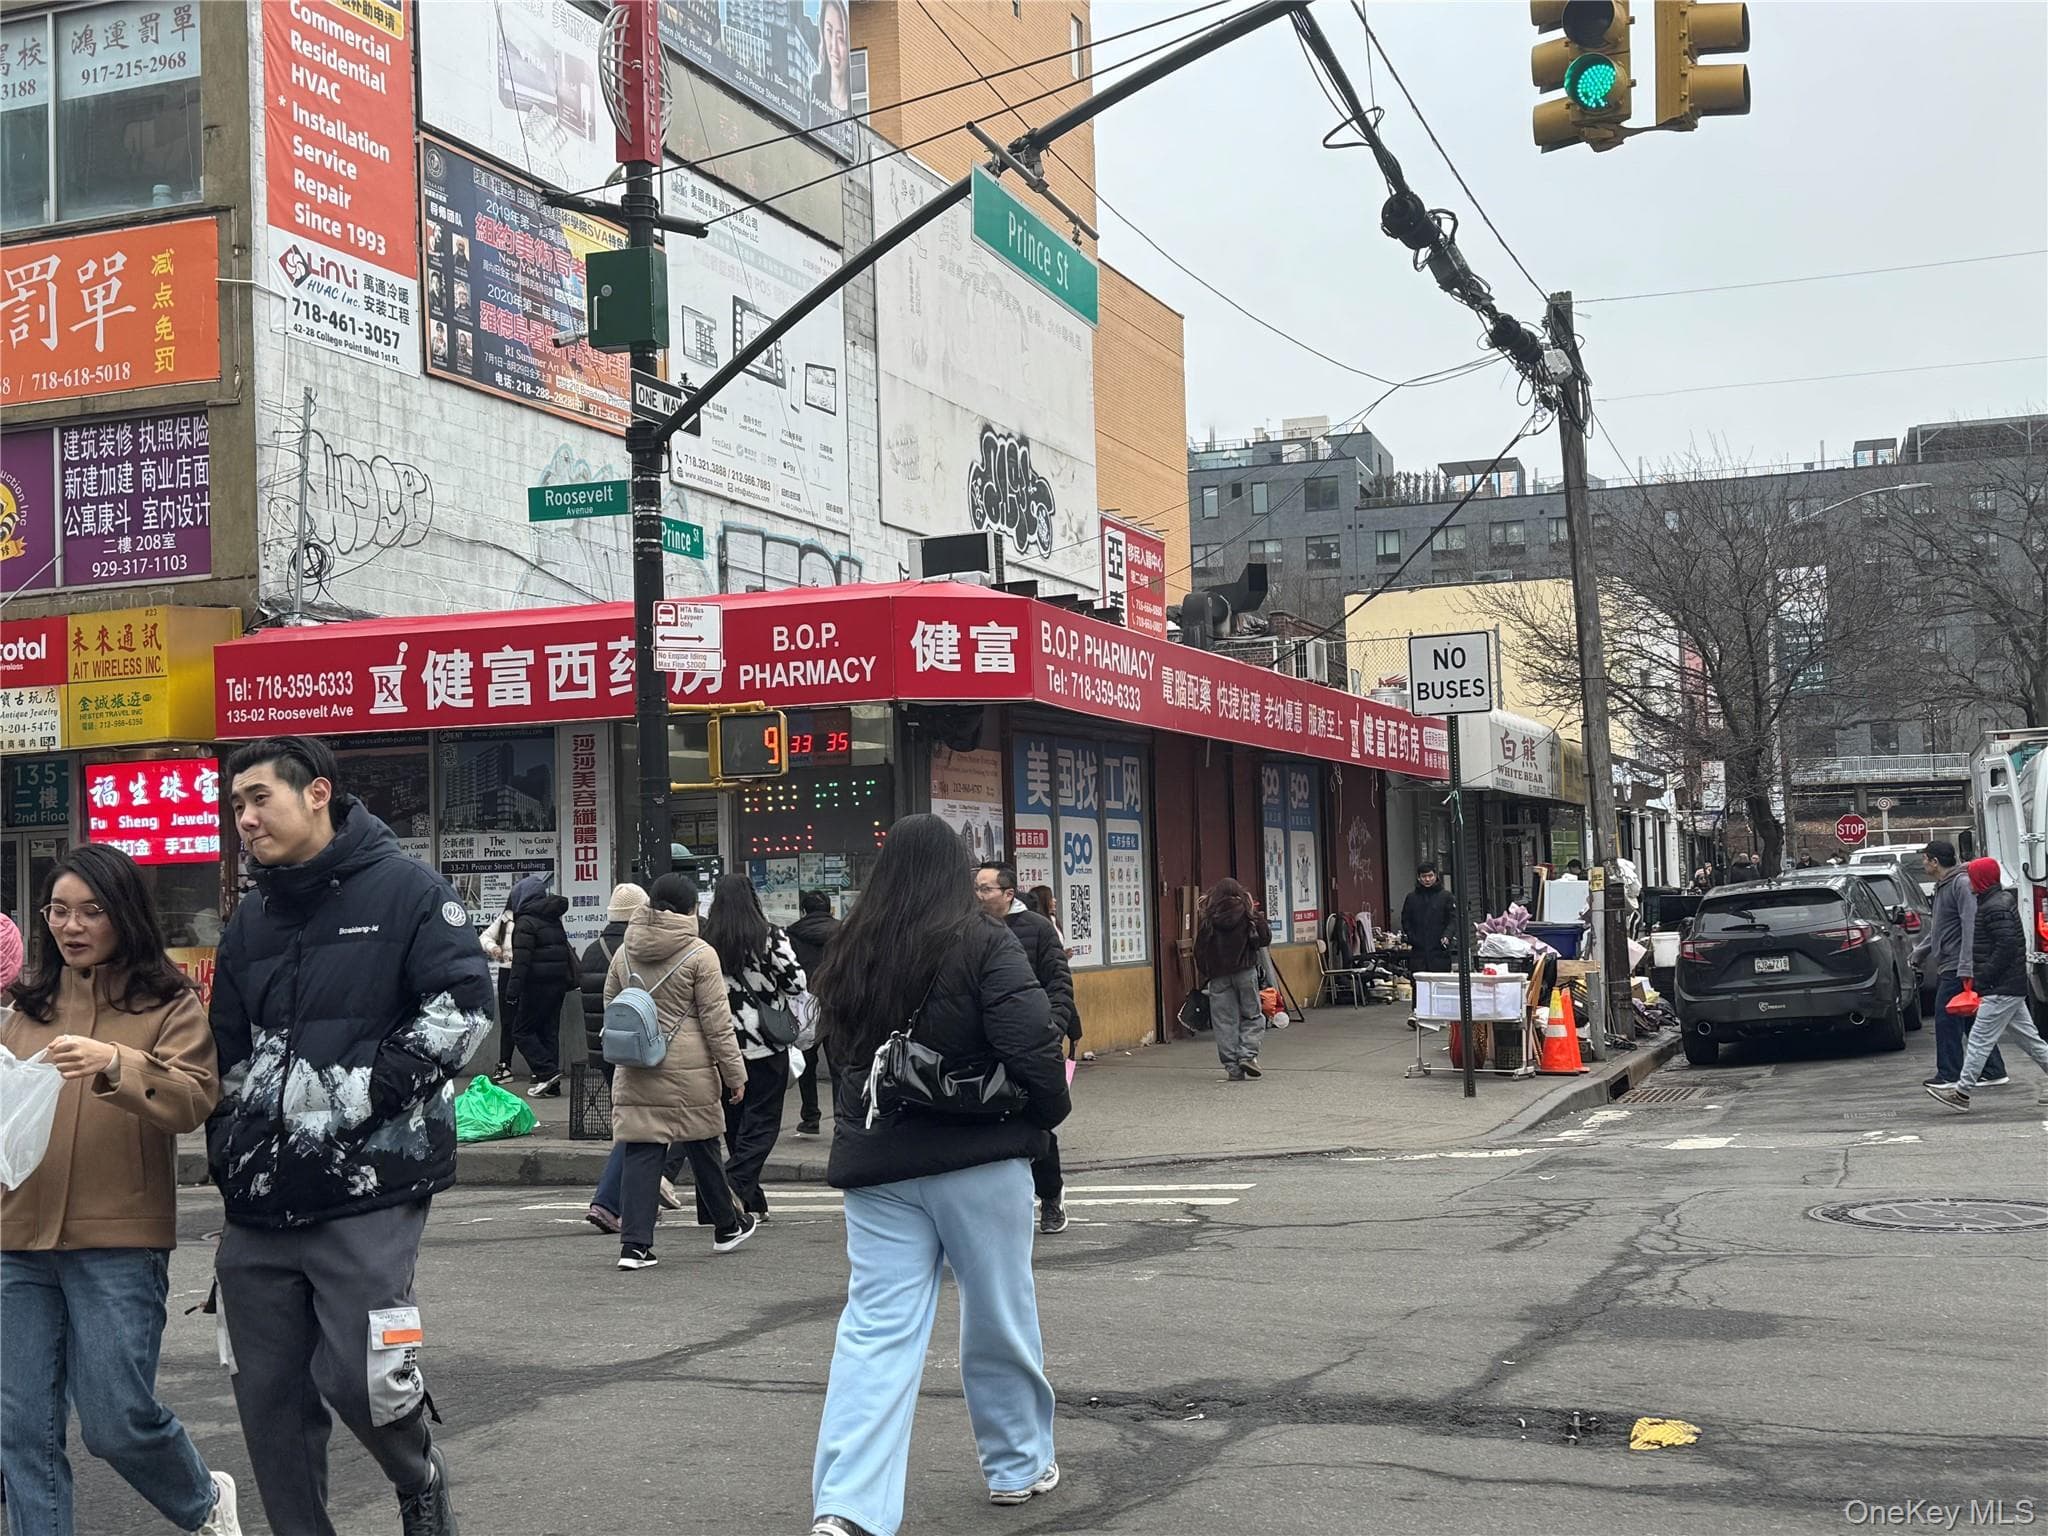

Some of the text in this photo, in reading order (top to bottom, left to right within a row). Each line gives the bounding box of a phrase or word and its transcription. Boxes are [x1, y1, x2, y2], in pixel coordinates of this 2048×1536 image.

[290, 0, 391, 65] Commercial
[81, 51, 187, 86] 917-215-2968
[290, 29, 387, 96] Residential
[291, 63, 341, 105] HVAC
[292, 101, 390, 163] Installation
[293, 135, 358, 180] Service
[293, 168, 352, 211] Repair
[294, 202, 387, 256] Since 1993
[498, 251, 518, 269] New
[520, 261, 541, 279] York
[1008, 210, 1070, 291] Prince St
[0, 250, 137, 353] 罰單
[292, 297, 400, 350] 718-461-3057
[31, 362, 131, 391] 718-618-5018
[638, 388, 658, 409] ONE
[663, 396, 683, 413] WAY
[65, 454, 209, 500] 新建加建 商业店面
[545, 485, 614, 507] Roosevelt
[566, 506, 594, 516] Avenue
[661, 521, 700, 552] Prince St
[92, 555, 187, 578] 929-317-1103
[773, 623, 839, 652] B.O.P.
[910, 620, 1018, 674] 健富
[1041, 620, 1156, 682] B.O.P. PHARMACY
[73, 655, 164, 680] AIT WIRELESS INC.
[740, 656, 877, 690] PHARMACY
[1433, 647, 1466, 671] NO
[226, 670, 354, 702] Tel: 718-359-6333
[1046, 665, 1141, 712] Tel: 718-359-6333
[1417, 678, 1485, 701] BUSES
[226, 704, 354, 723] 135-02 Roosevelt Ave
[1307, 703, 1345, 741] 服務至上
[764, 726, 780, 765] 9
[790, 735, 813, 753] 33
[826, 732, 849, 752] 35
[1500, 729, 1538, 770] 白熊
[1026, 741, 1141, 812] 美国找工网
[1290, 772, 1310, 809] 500
[1497, 764, 1544, 784] WHITE BEAR
[15, 811, 37, 825] 2nd
[90, 812, 220, 830] Fu Sheng Jewelry
[1836, 823, 1866, 836] STOP
[484, 848, 512, 857] Prince
[489, 836, 506, 847] The
[1063, 831, 1093, 876] 500
[471, 863, 492, 871] Prince
